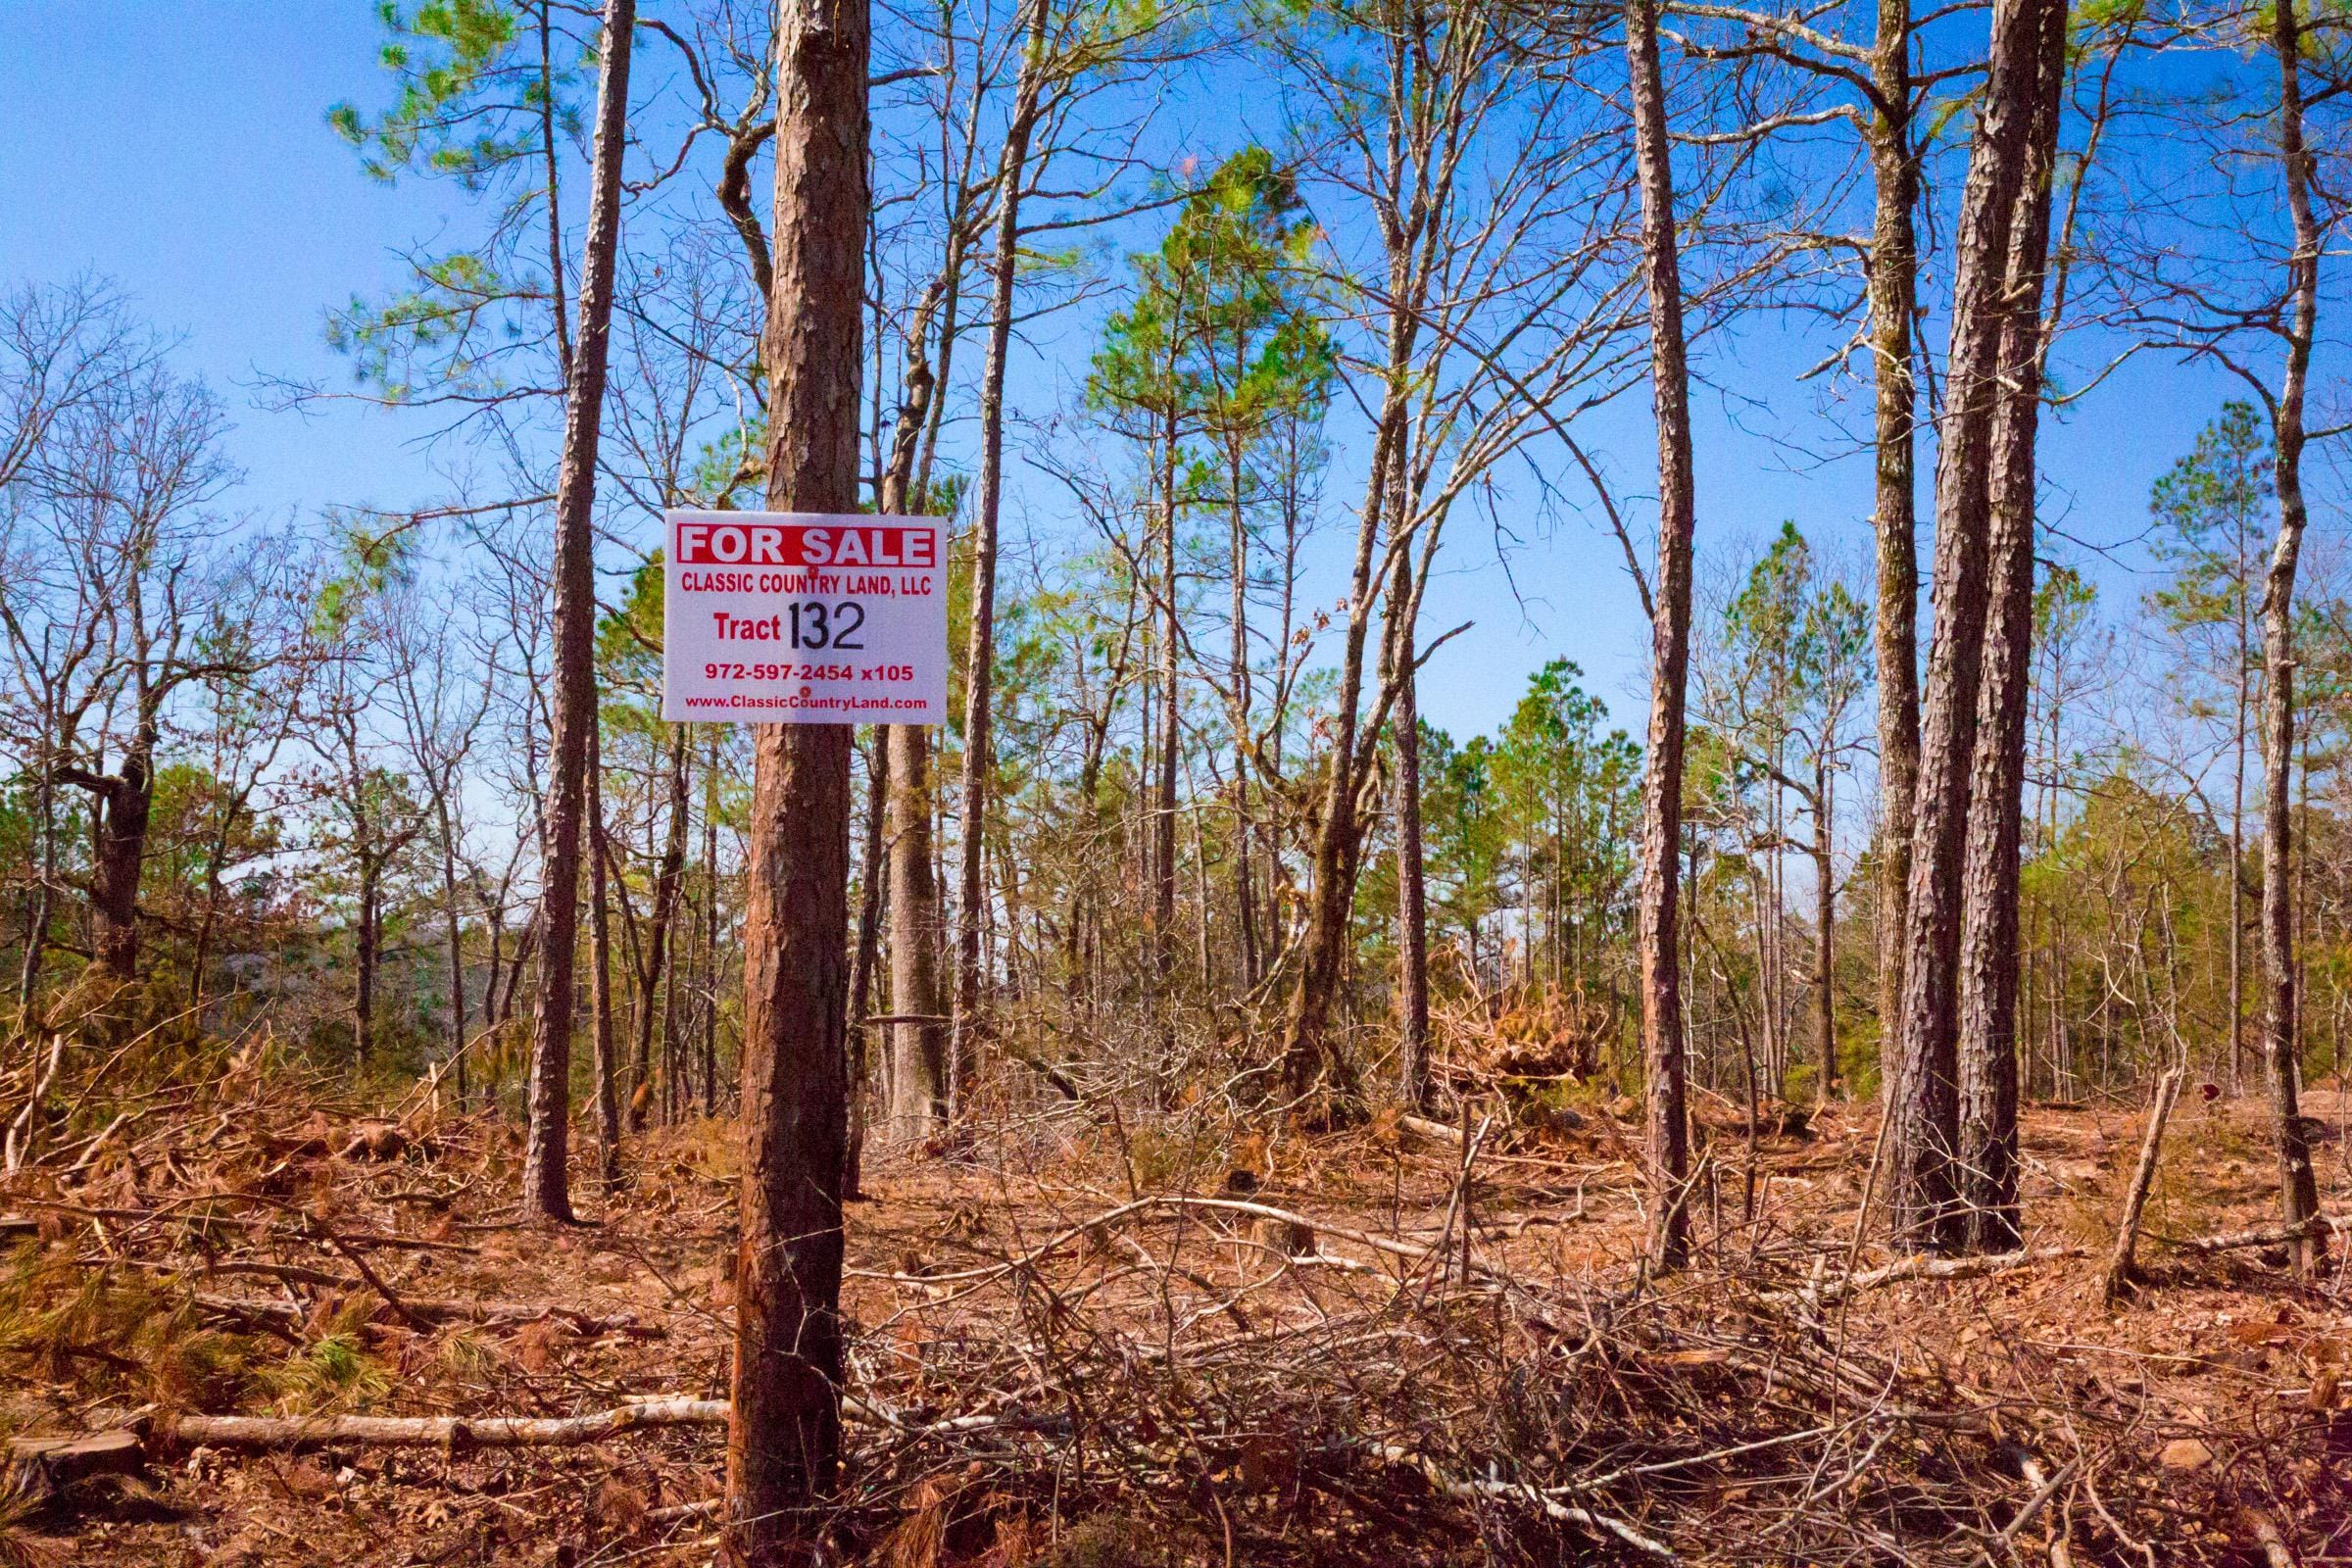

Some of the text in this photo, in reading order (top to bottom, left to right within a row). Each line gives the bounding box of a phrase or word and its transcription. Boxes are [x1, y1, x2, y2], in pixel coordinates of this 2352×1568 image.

[680, 526, 931, 565] FOR SALE
[681, 572, 931, 599] CLASSIC COUNTRY LAND, LLC
[713, 601, 864, 650] Tract 132
[705, 663, 913, 681] 972-597-2454 x105
[685, 694, 927, 711] www.ClassicCountryLand.com
